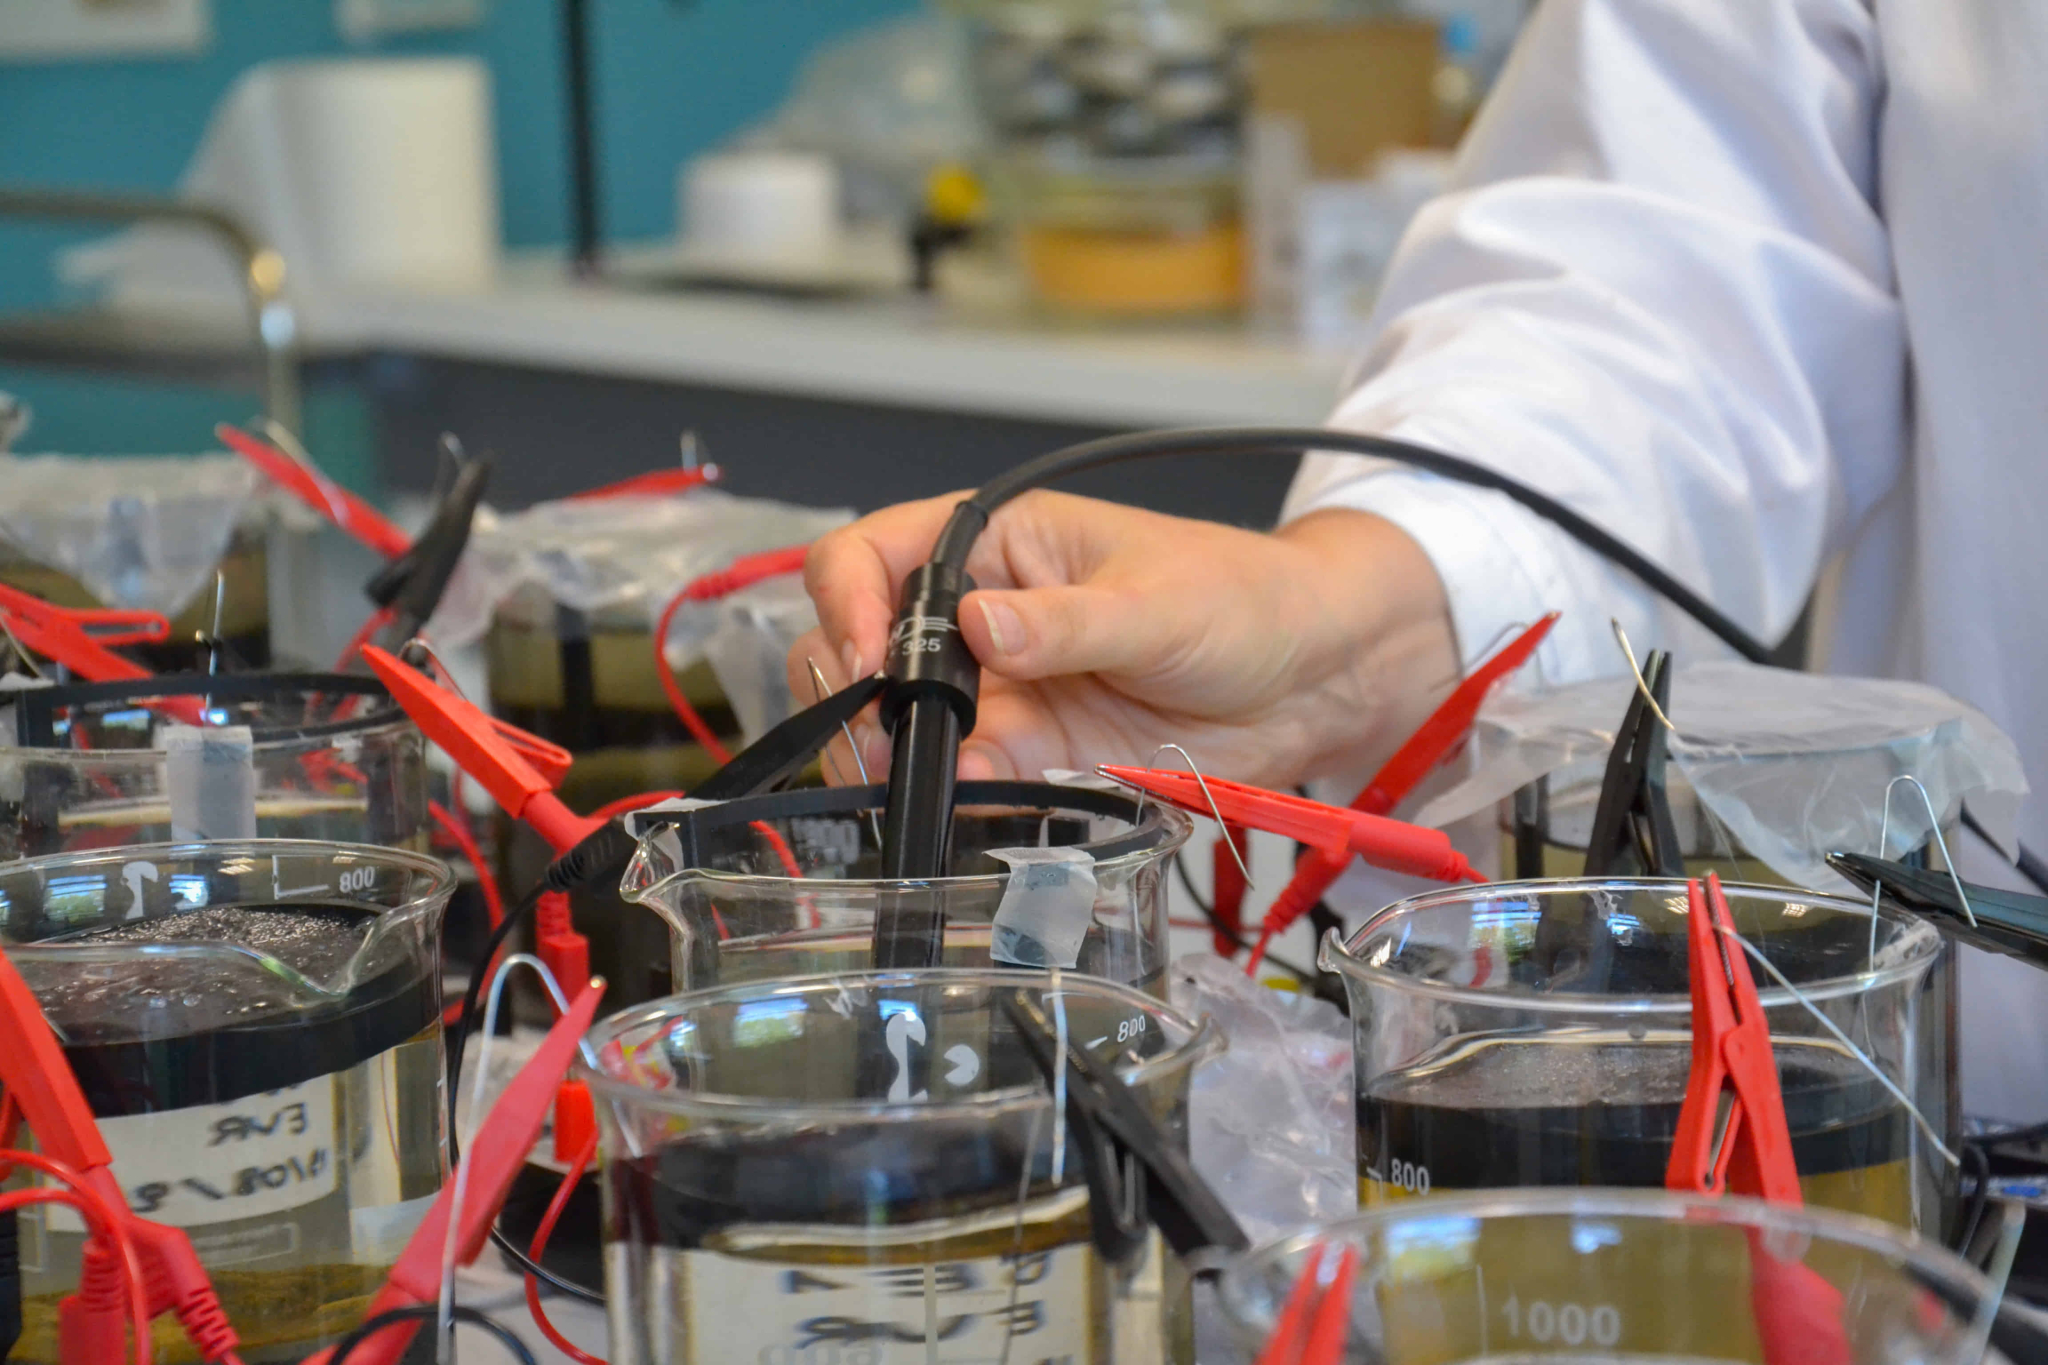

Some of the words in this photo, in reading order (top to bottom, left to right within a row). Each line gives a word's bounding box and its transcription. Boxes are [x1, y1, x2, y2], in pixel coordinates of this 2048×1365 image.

[339, 866, 375, 893] 800
[1117, 1014, 1146, 1043] 800
[1391, 1157, 1430, 1196] 800
[1502, 1293, 1622, 1346] 1000
